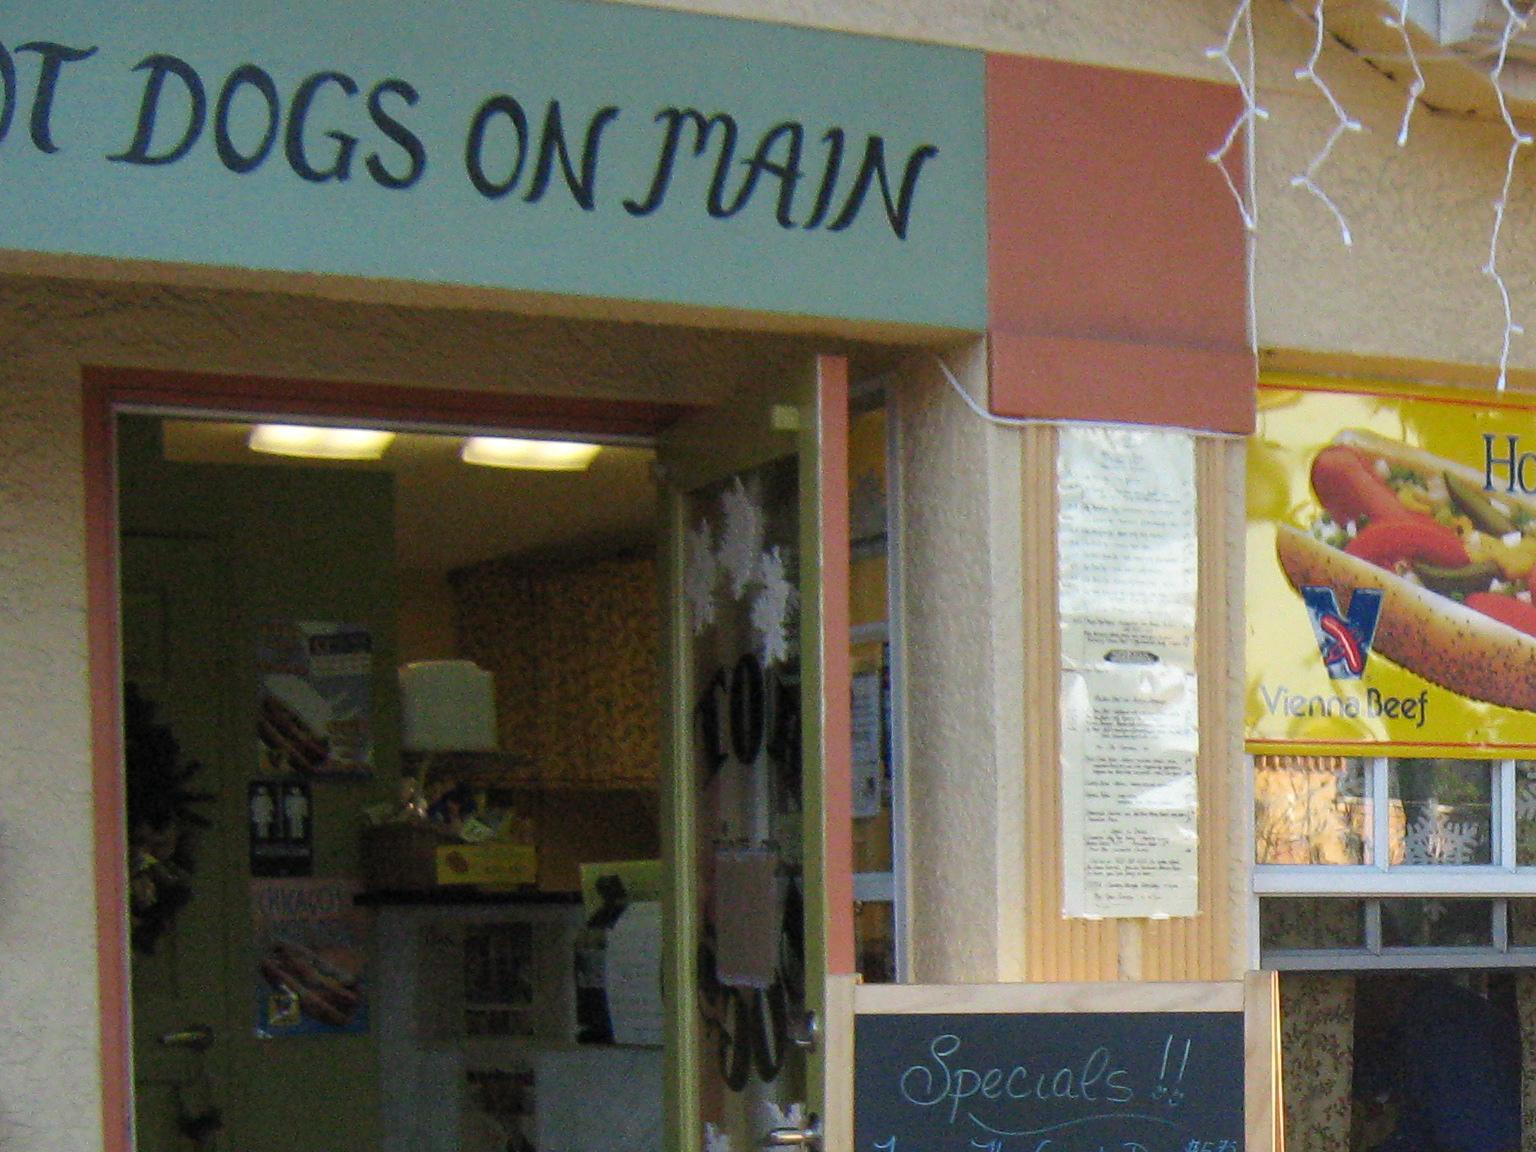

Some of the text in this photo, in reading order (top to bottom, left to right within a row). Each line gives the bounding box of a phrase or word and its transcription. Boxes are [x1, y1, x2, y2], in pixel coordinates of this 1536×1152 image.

[0, 41, 937, 240] T DOGS ON MAIN
[1259, 685, 1429, 728] Vienna Beef
[900, 1034, 1133, 1124] Specials
